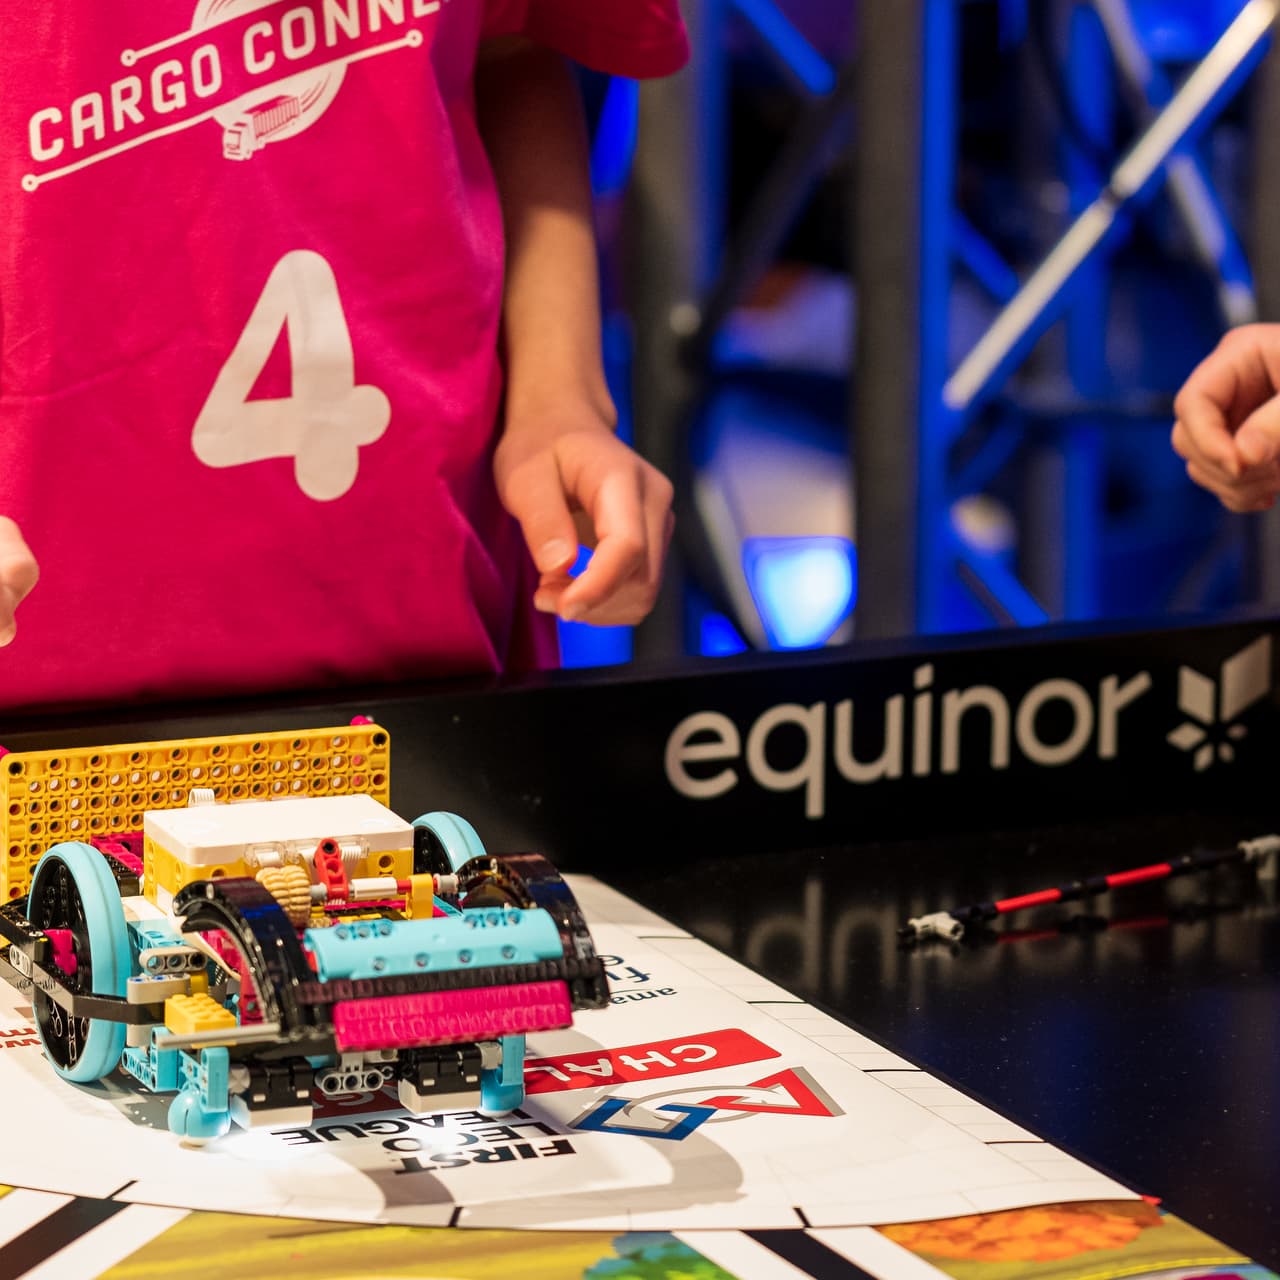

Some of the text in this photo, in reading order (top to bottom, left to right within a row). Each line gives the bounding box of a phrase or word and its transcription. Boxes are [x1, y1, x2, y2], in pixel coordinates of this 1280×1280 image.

[28, 43, 222, 162] CARGO
[191, 249, 391, 501] 4
[665, 663, 1153, 819] equinor
[524, 1044, 718, 1082] CHAL
[393, 1139, 577, 1175] FIRST
